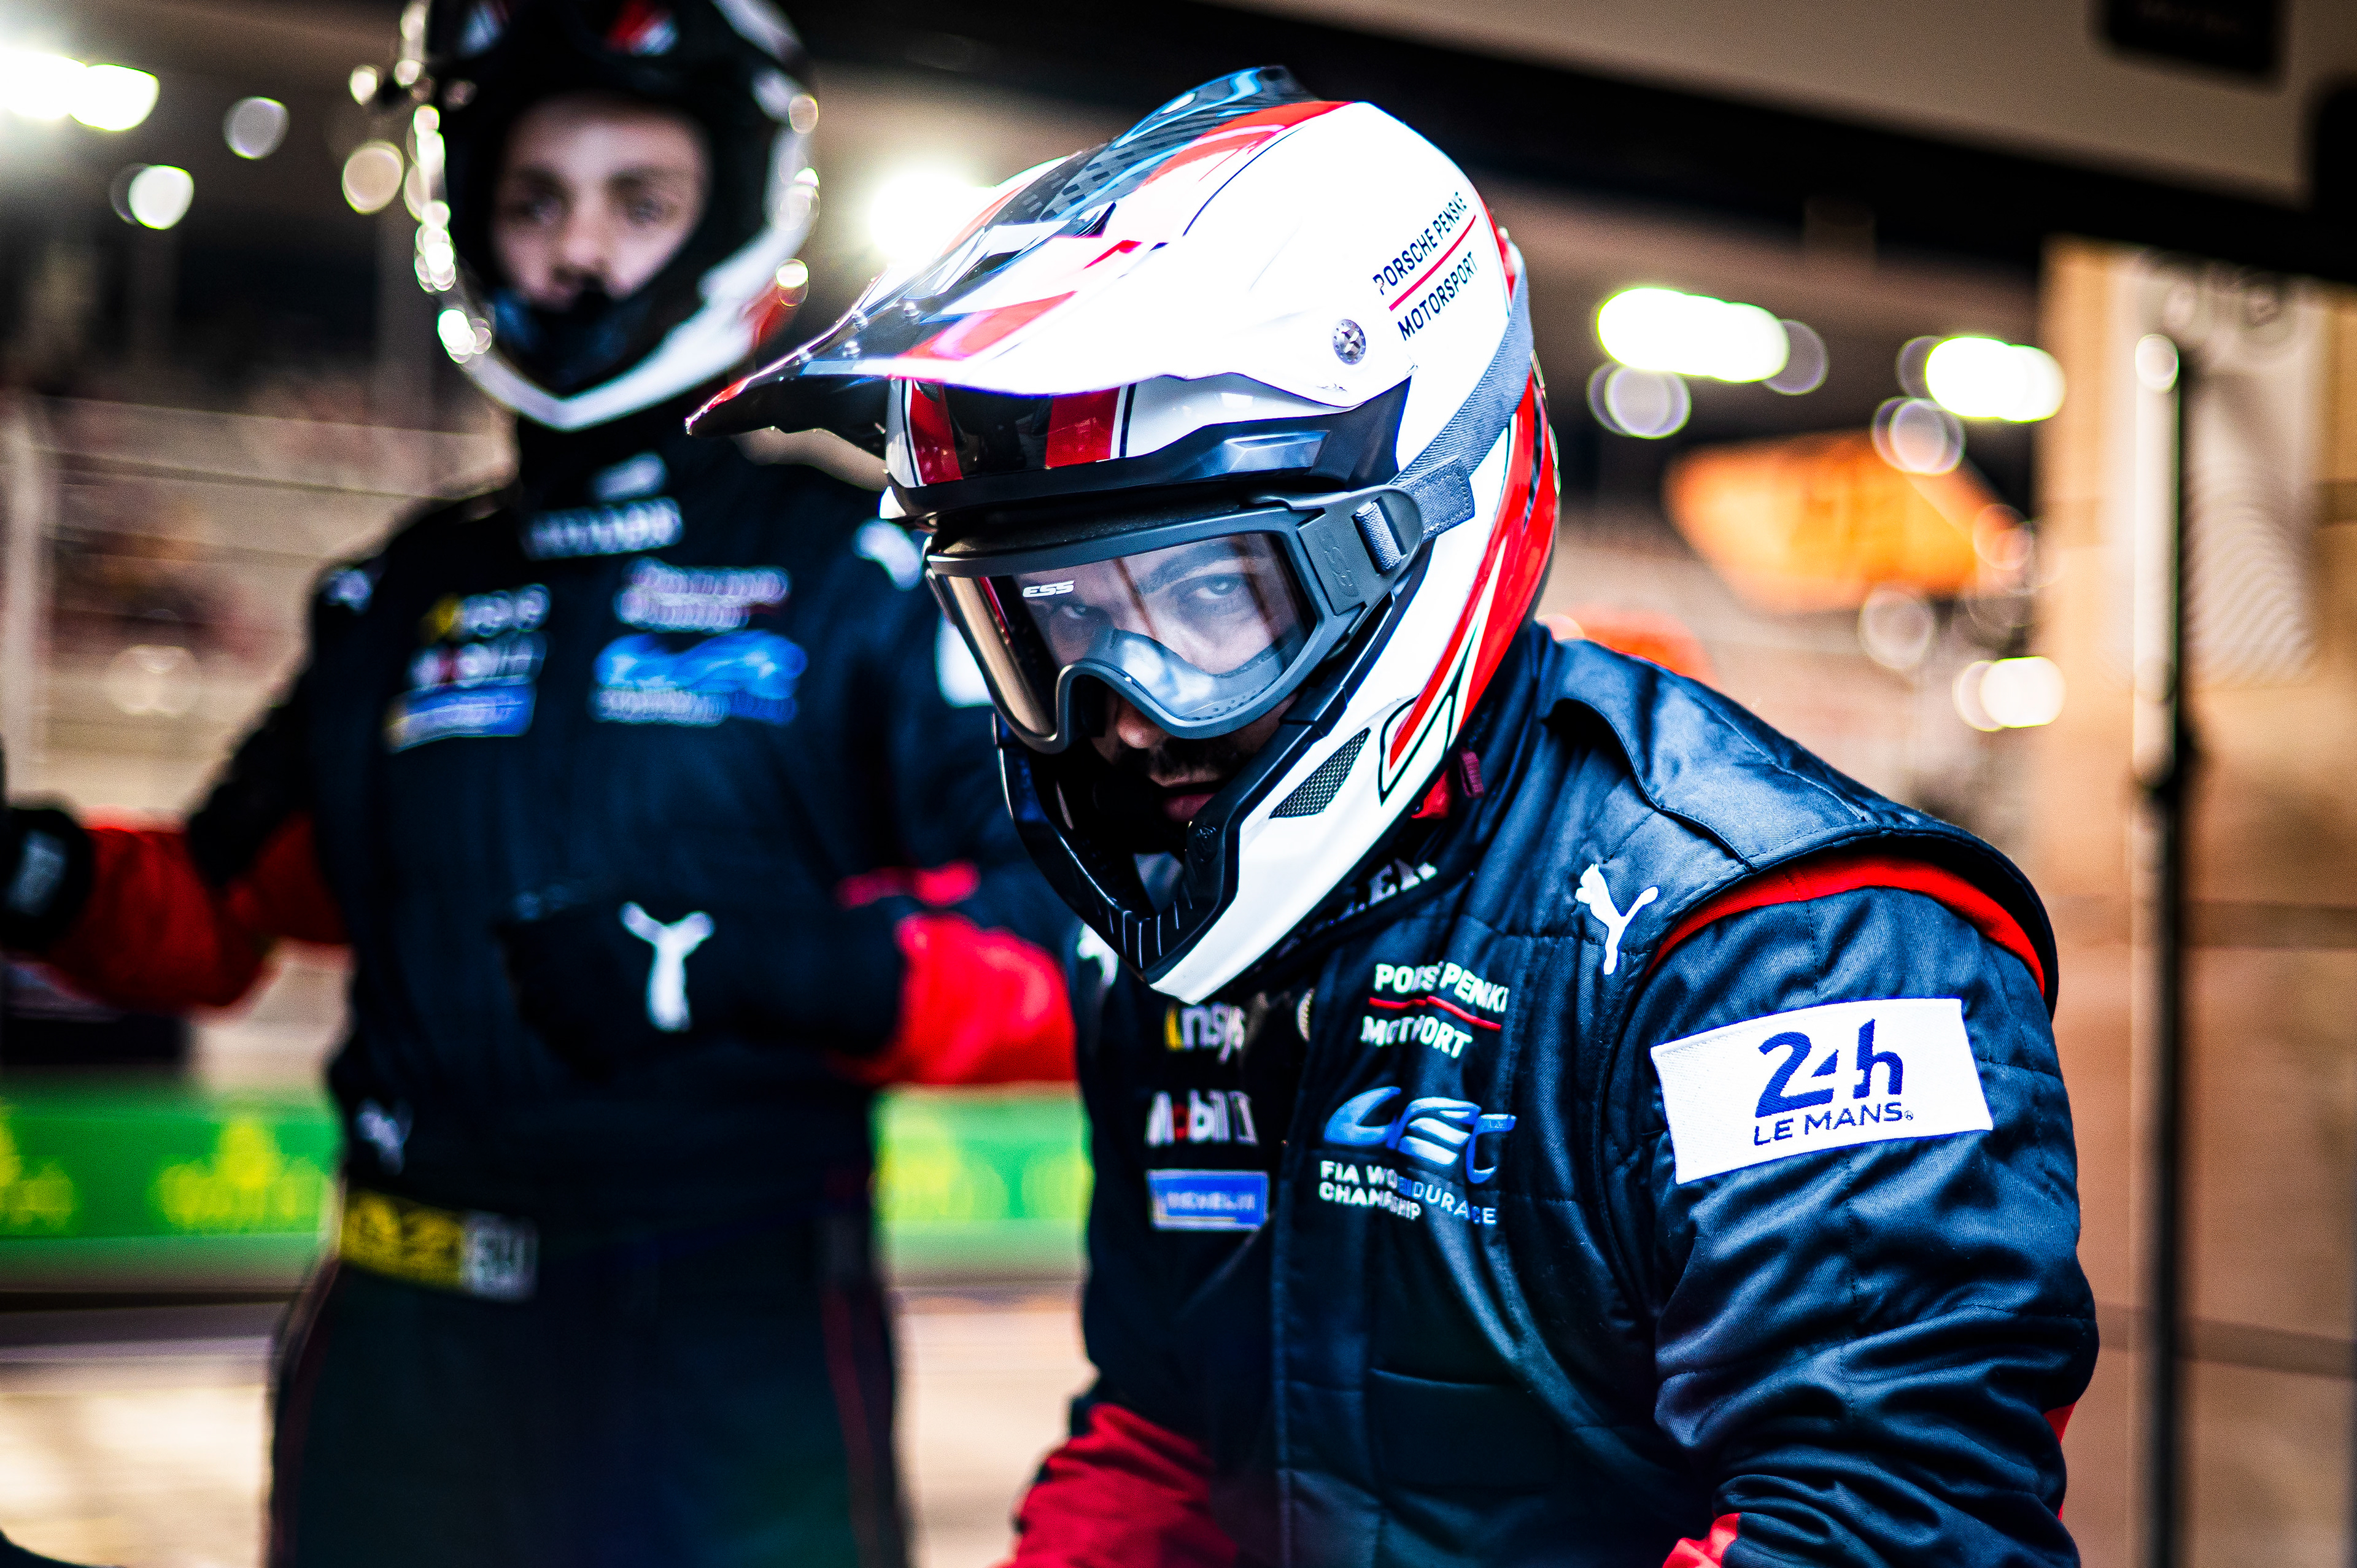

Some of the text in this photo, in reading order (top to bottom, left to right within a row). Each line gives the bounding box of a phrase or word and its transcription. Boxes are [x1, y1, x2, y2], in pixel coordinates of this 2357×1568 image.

[1397, 251, 1477, 341] MOTORSPORT
[1022, 580, 1075, 598] ESS
[1755, 1018, 1903, 1118] 24h
[1754, 1102, 1903, 1146] LE MANS
[1320, 1160, 1360, 1186] FIA
